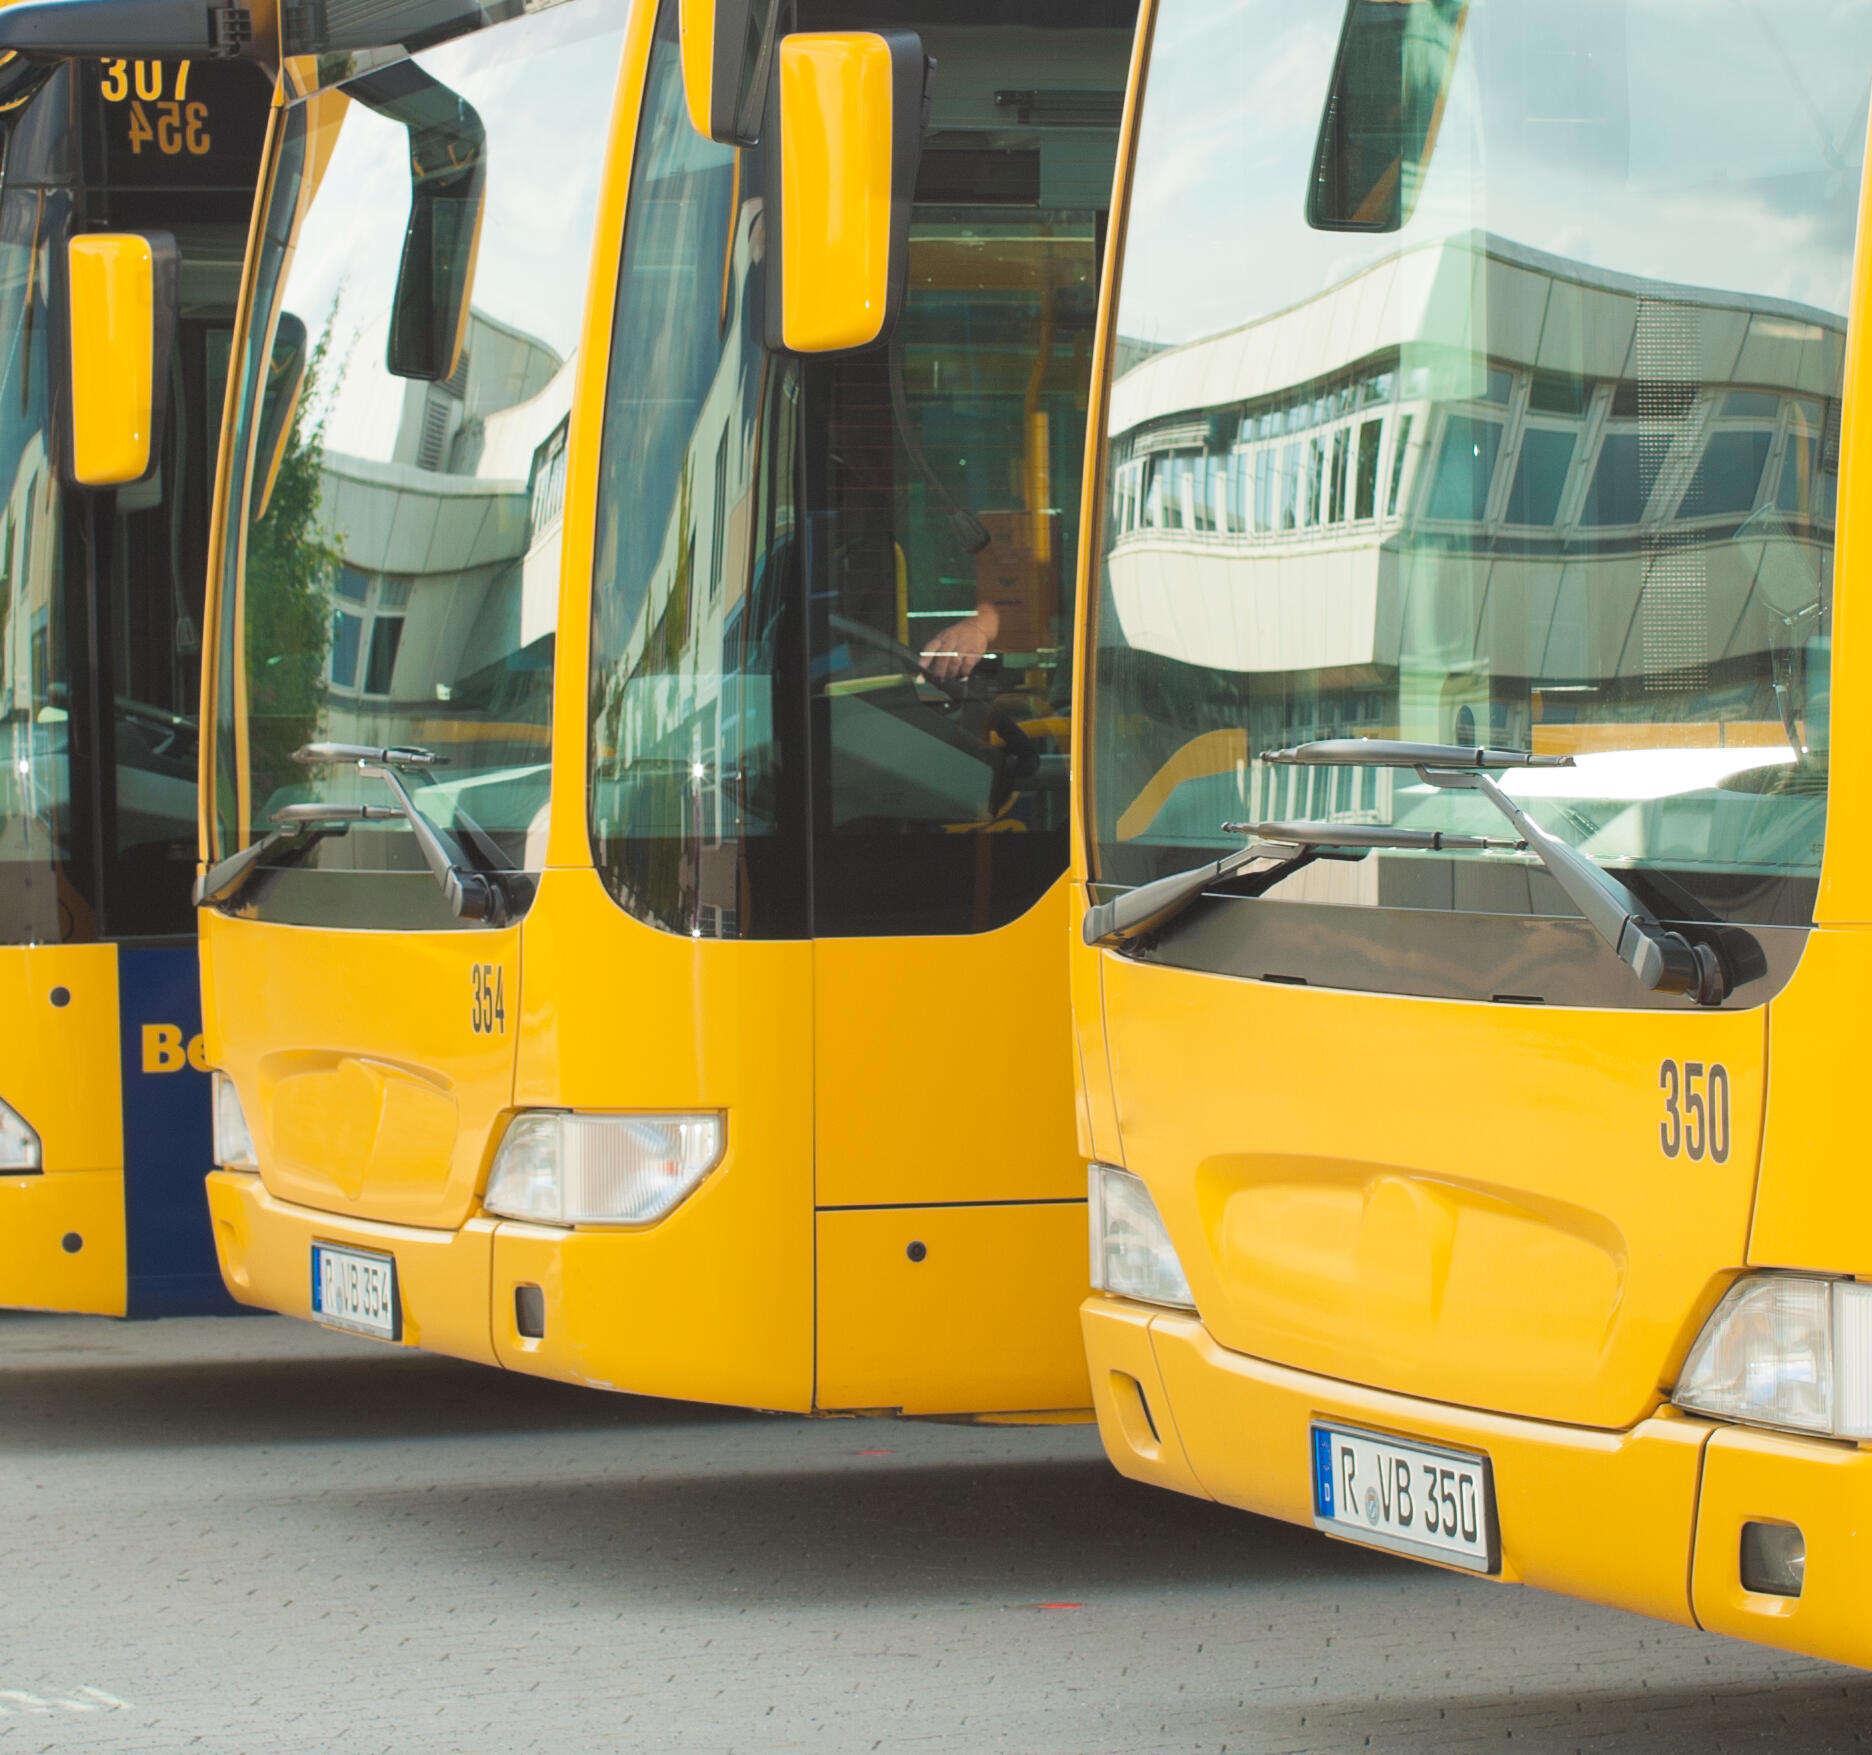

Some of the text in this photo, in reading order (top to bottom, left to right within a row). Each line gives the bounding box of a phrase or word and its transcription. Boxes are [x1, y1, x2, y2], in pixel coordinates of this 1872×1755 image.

[472, 963, 504, 1033] 354
[1660, 1058, 1729, 1164] 350
[325, 1258, 388, 1320] R VB 354
[1340, 1445, 1360, 1515] R
[1377, 1453, 1414, 1527] VB
[1423, 1464, 1478, 1543] 350
